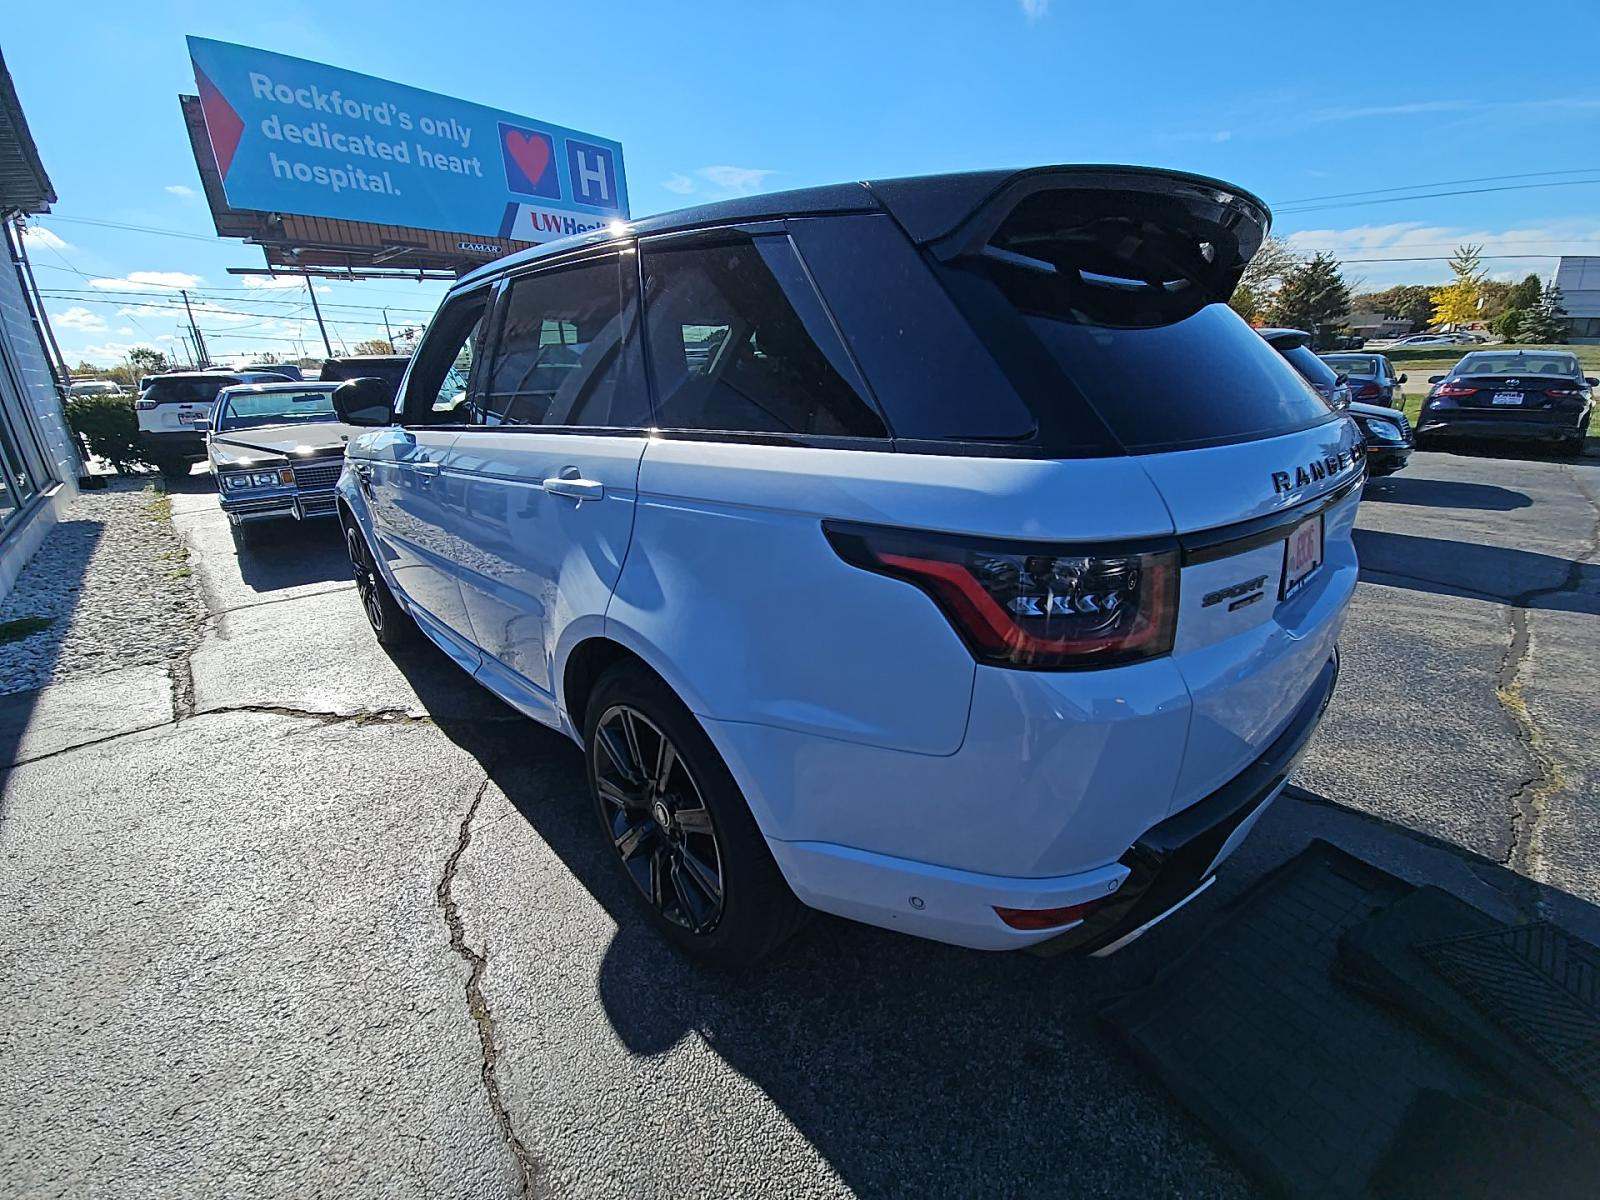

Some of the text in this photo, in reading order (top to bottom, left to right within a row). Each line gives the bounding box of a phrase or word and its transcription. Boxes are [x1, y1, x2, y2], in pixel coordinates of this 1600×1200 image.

[249, 71, 472, 149] Rockford's only
[261, 114, 483, 178] dedicated heart
[269, 152, 402, 196] hospital.
[576, 150, 609, 200] H
[461, 241, 499, 253] LAMAR
[1271, 452, 1349, 494] RANGE
